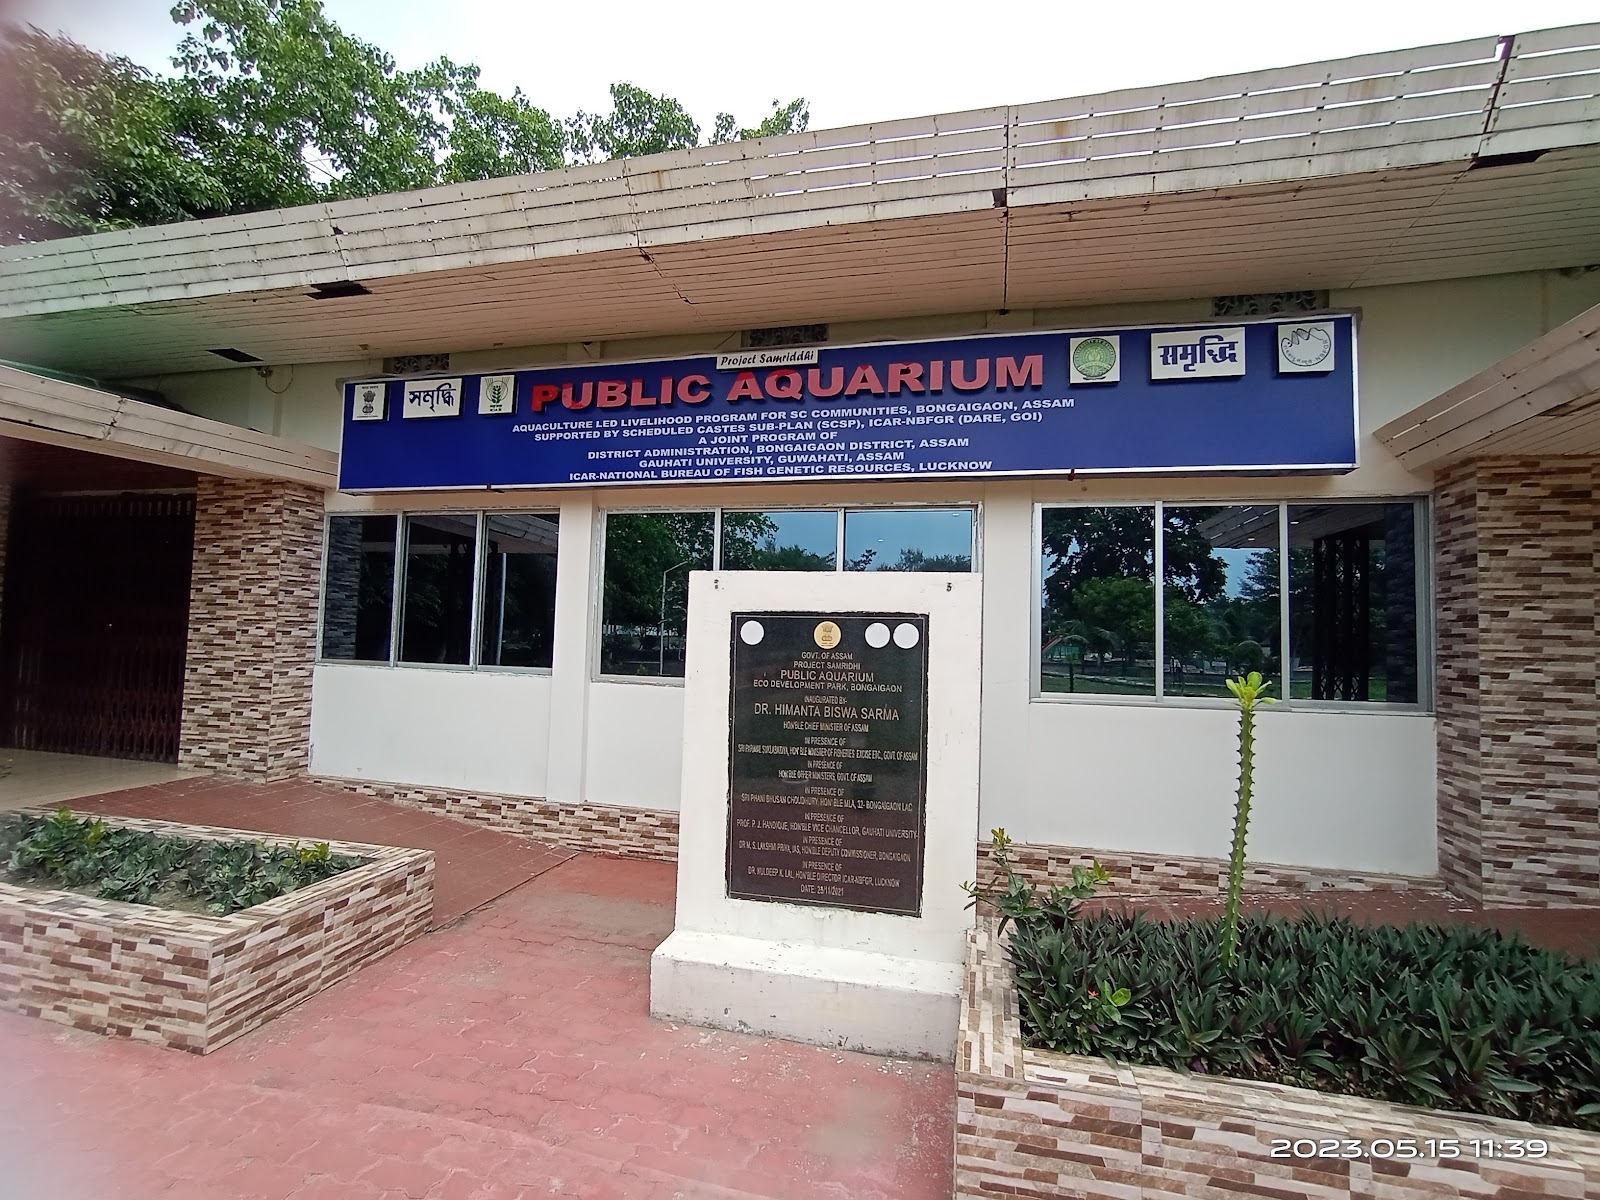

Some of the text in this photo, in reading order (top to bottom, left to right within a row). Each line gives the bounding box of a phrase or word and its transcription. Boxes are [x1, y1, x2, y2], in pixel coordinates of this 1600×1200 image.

[720, 351, 814, 366] Project Samriddhi
[1158, 335, 1238, 372] समृद्धि
[531, 354, 1043, 412] PUBLIC AQUARIUM
[408, 383, 456, 412] সমৃদ্ধি
[512, 399, 1074, 432] AQUACULTURE LED LIVELIHOOD PROGRAM FOR SC COMMUNITIES, BONGAIGAON, ASSAM
[534, 412, 1042, 441] SUPPORTED BY SCHEDULED CASTES SUB-PLAN (SCSP), ICAR-NBFGR (DARE, GOI)
[698, 431, 838, 445] A JOINT PROGRAM OF
[588, 438, 969, 459] DISTRICT ADMINISTRATION, BONGAIGAON DISTRICT, ASSAM
[639, 452, 904, 468] GAUHATI UNIVERSITY, GUWAHATI, ASSAM
[570, 461, 992, 481] ICAR-NATIONAL BUREAU OF FISH GENETIC RESOURCES, LUCKNOW
[821, 652, 830, 660] OF
[831, 652, 853, 660] ASSAM
[793, 661, 861, 670] PROJECT SAMRIDHI
[780, 670, 874, 682] PUBLIC AQUARIUM
[753, 679, 903, 692] ECO DEVELOPMENT PARK, BONGAIGAON
[804, 695, 838, 704] INAUGURATED
[754, 703, 900, 720] DR. HIMANTA BISWA SARMA
[804, 721, 819, 731] CHIEF
[820, 721, 843, 732] MINISTER
[843, 723, 851, 732] OF
[851, 723, 869, 733] ASSAM
[804, 736, 847, 746] IN PRESENCE OF
[827, 748, 834, 757] OF
[896, 751, 903, 760] OF
[903, 751, 918, 761] ASSAM
[807, 760, 843, 770] IN PRESENCE OF
[850, 773, 857, 782] OF
[856, 773, 873, 783] ASSAM
[741, 792, 750, 802] SRI
[804, 786, 844, 797] IN PRESENCE OF
[804, 812, 844, 823] IN PRESENCE OF
[812, 823, 824, 832] VICE
[861, 826, 884, 837] GAUHATI
[802, 835, 842, 846] IN PRESENCE OF
[821, 846, 839, 856] DEPUTY
[802, 860, 842, 871] IN PRESENCE OF
[816, 872, 841, 883] DIRECTOR
